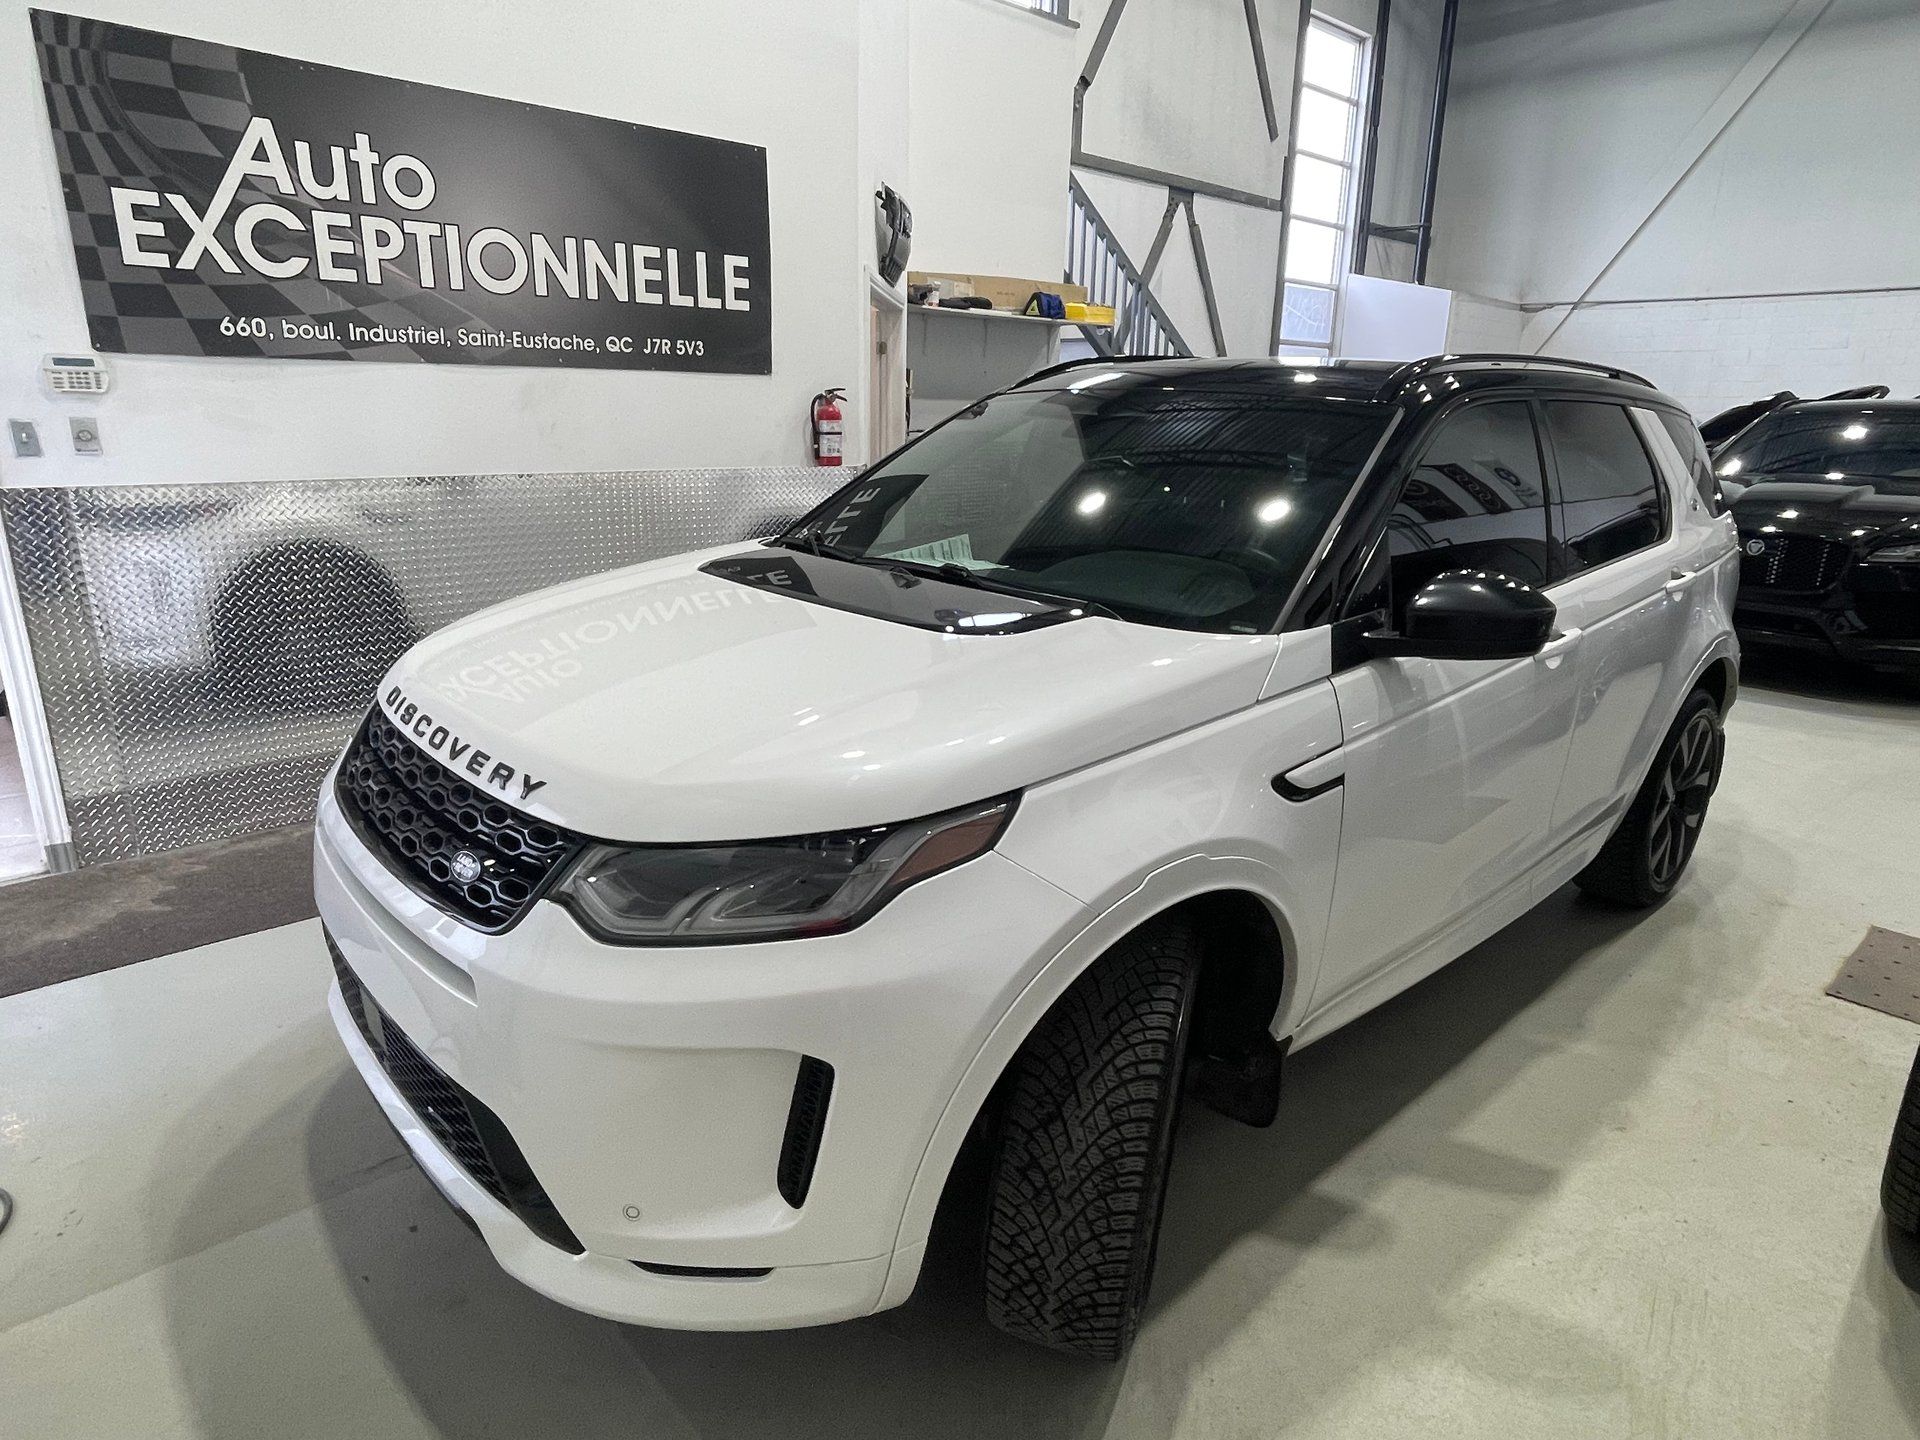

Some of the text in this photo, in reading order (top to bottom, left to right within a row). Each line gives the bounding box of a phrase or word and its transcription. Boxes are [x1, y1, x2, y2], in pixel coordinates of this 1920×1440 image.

[216, 115, 437, 212] Auto
[109, 186, 751, 311] EXCEPTIONNELLE
[219, 316, 705, 357] 660, boul. Industriel, Saint-Eustache, QC J7R 5V3
[385, 685, 548, 801] DISCOVERY
